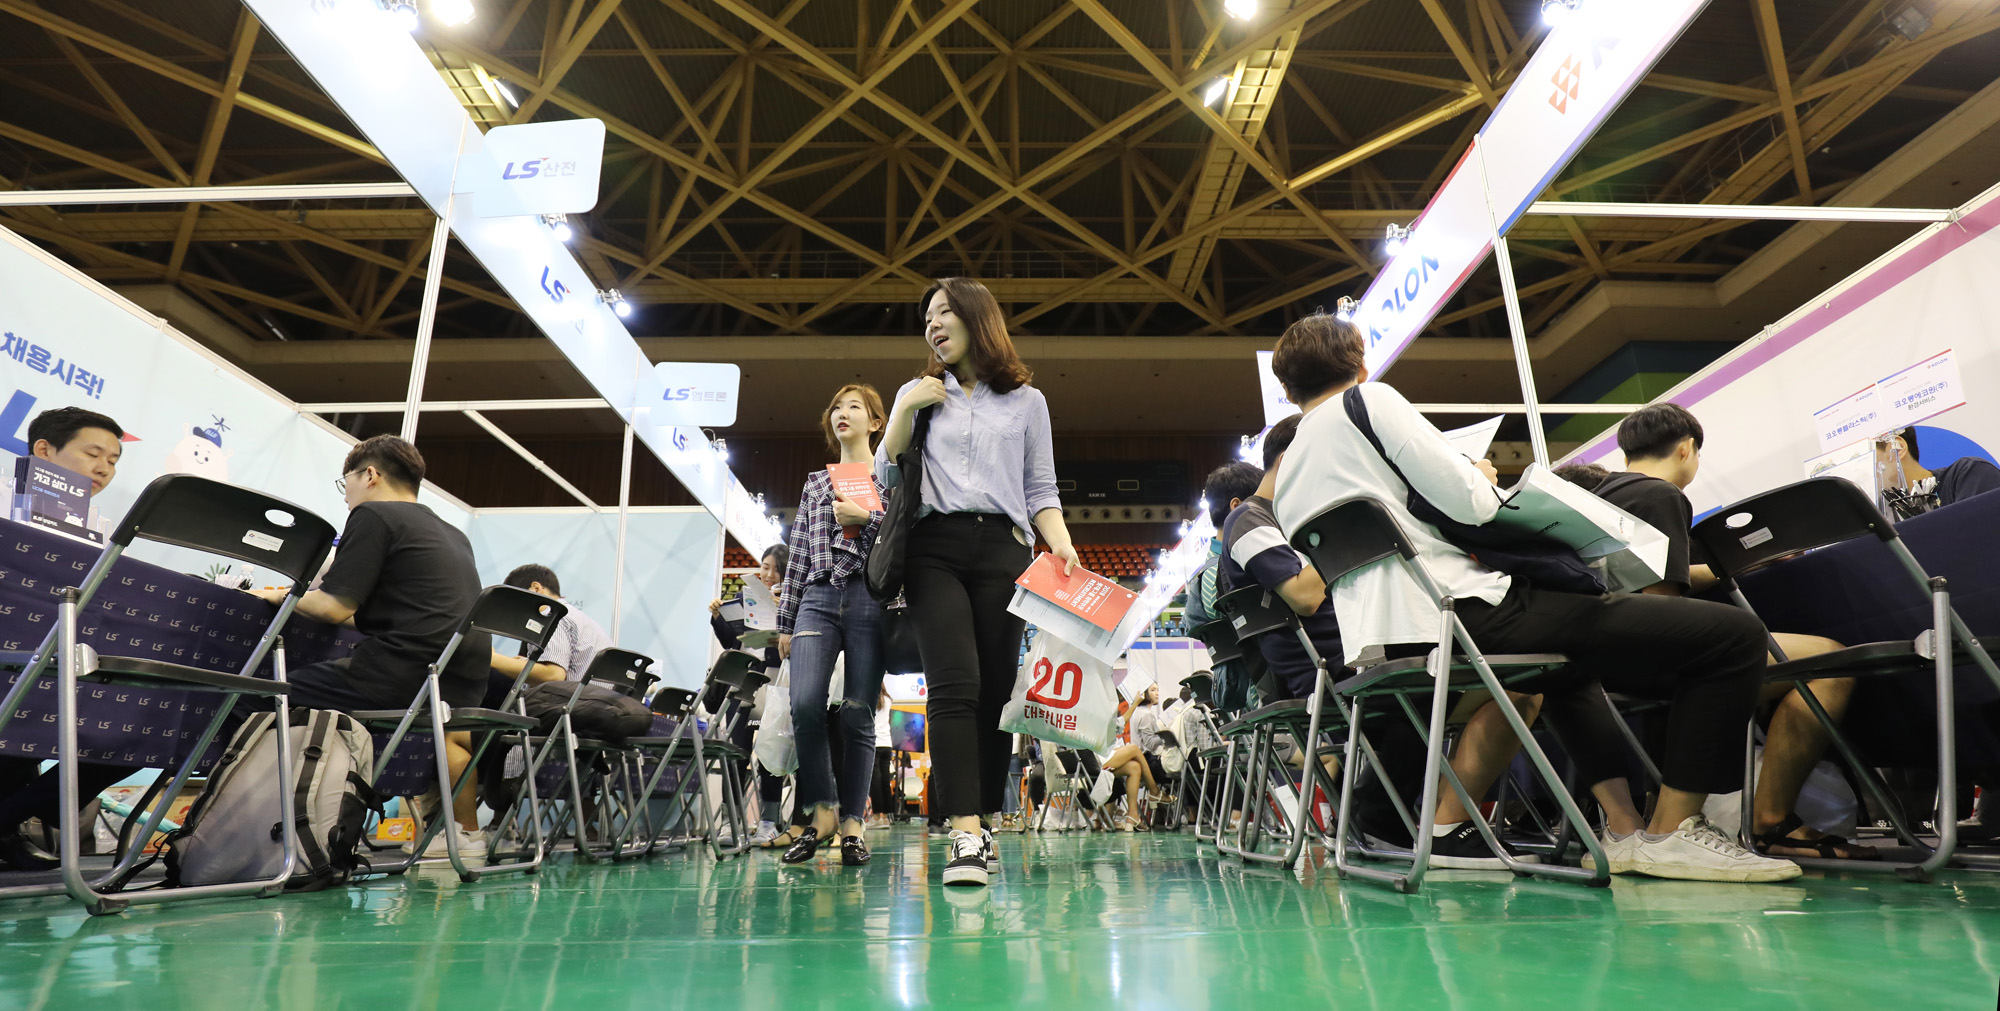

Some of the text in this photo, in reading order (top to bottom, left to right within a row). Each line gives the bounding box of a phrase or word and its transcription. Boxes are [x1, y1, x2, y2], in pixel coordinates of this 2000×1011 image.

[541, 265, 567, 304] LS
[0, 331, 105, 400] 채용시작!
[69, 485, 86, 497] LS
[1024, 704, 1077, 731] 대학내일
